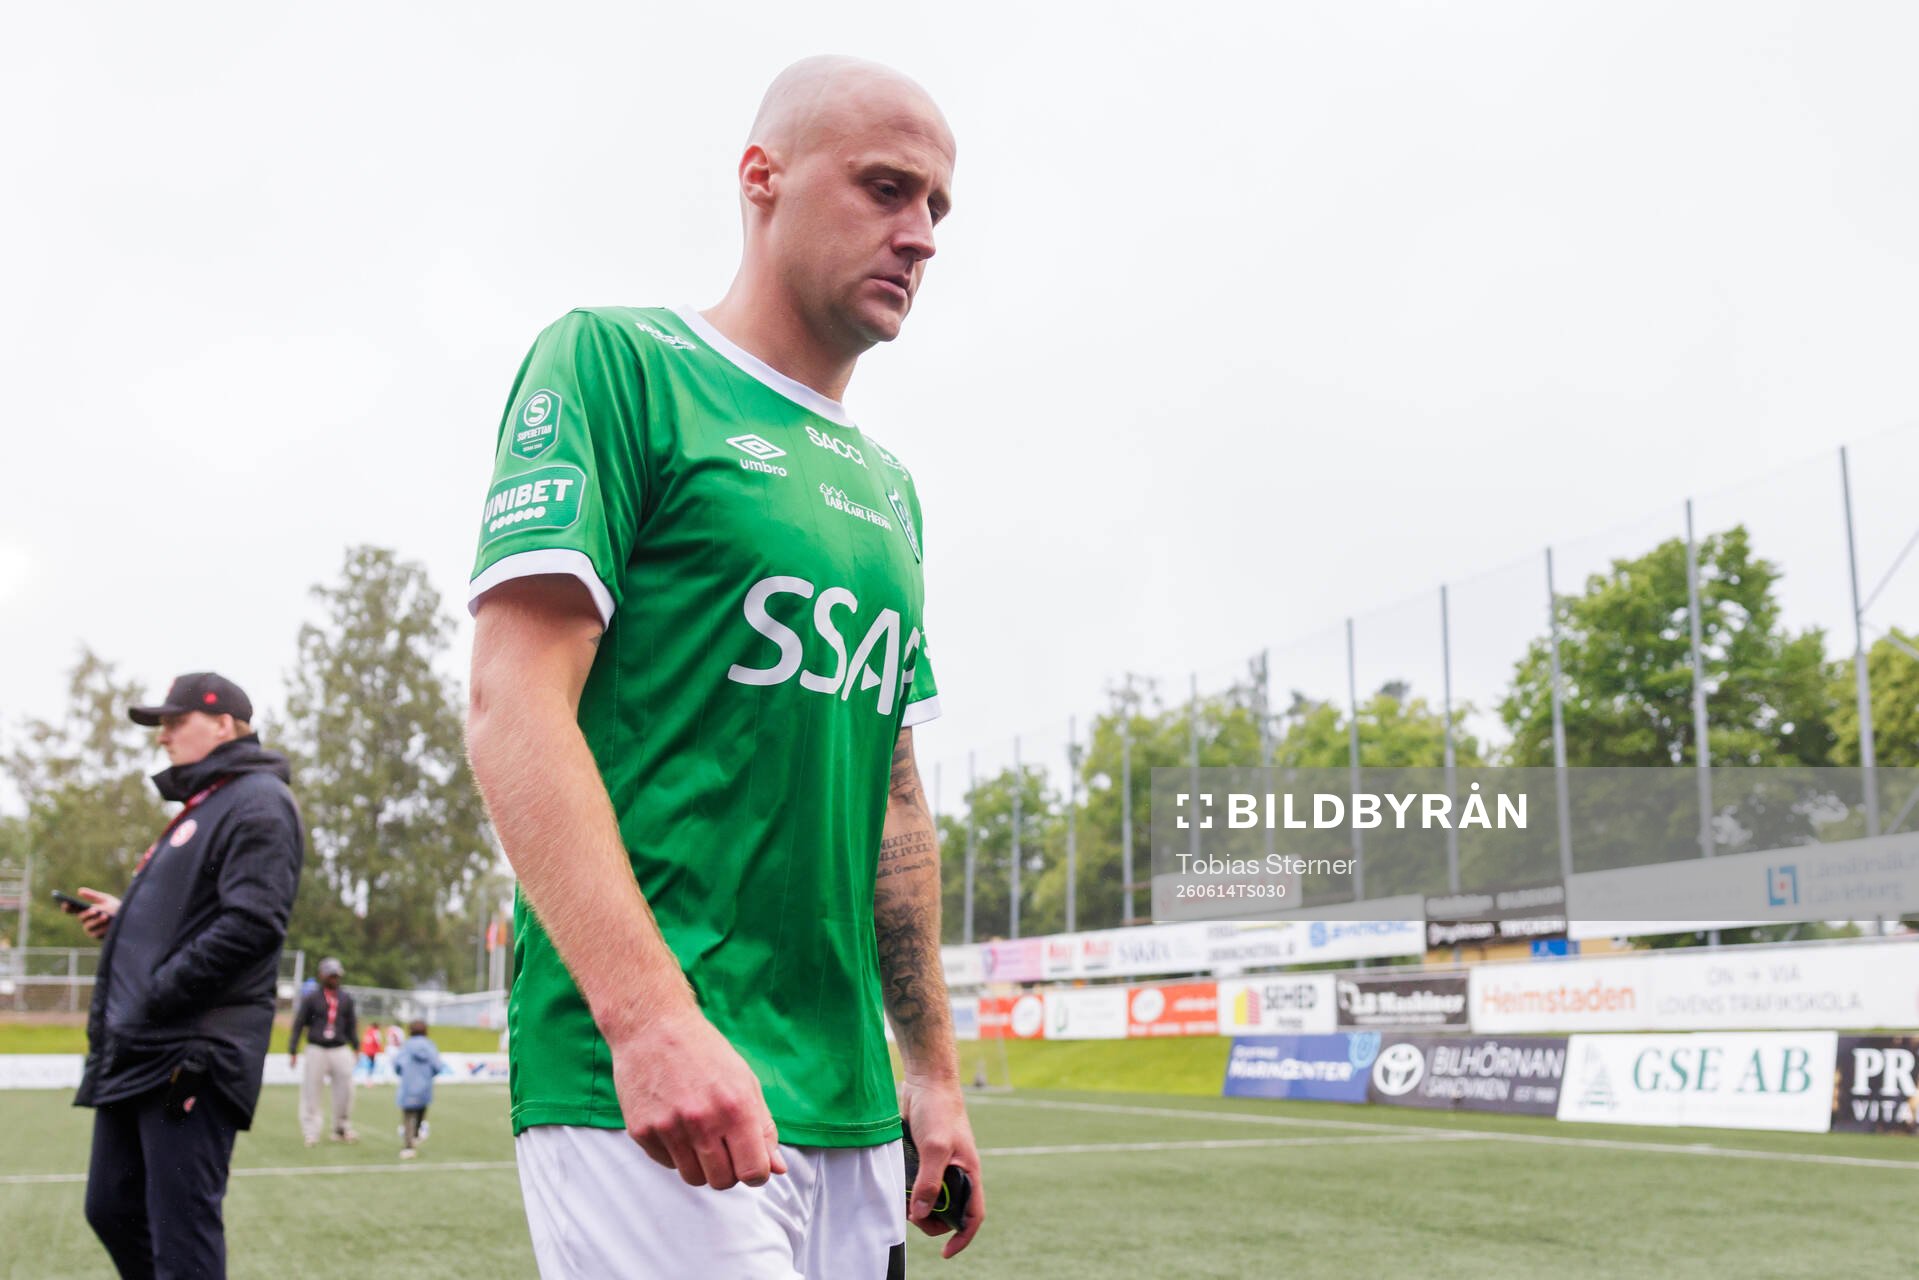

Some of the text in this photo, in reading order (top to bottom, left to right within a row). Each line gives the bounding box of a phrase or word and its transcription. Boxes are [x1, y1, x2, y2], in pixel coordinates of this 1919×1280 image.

[740, 458, 787, 477] umbro
[484, 479, 574, 524] UNIBET
[1482, 979, 1636, 1013] Heimstaden
[1432, 1041, 1567, 1080] BILHÖRNAN
[1632, 1047, 1812, 1093] GSE AB
[1851, 1100, 1919, 1125] VITA
